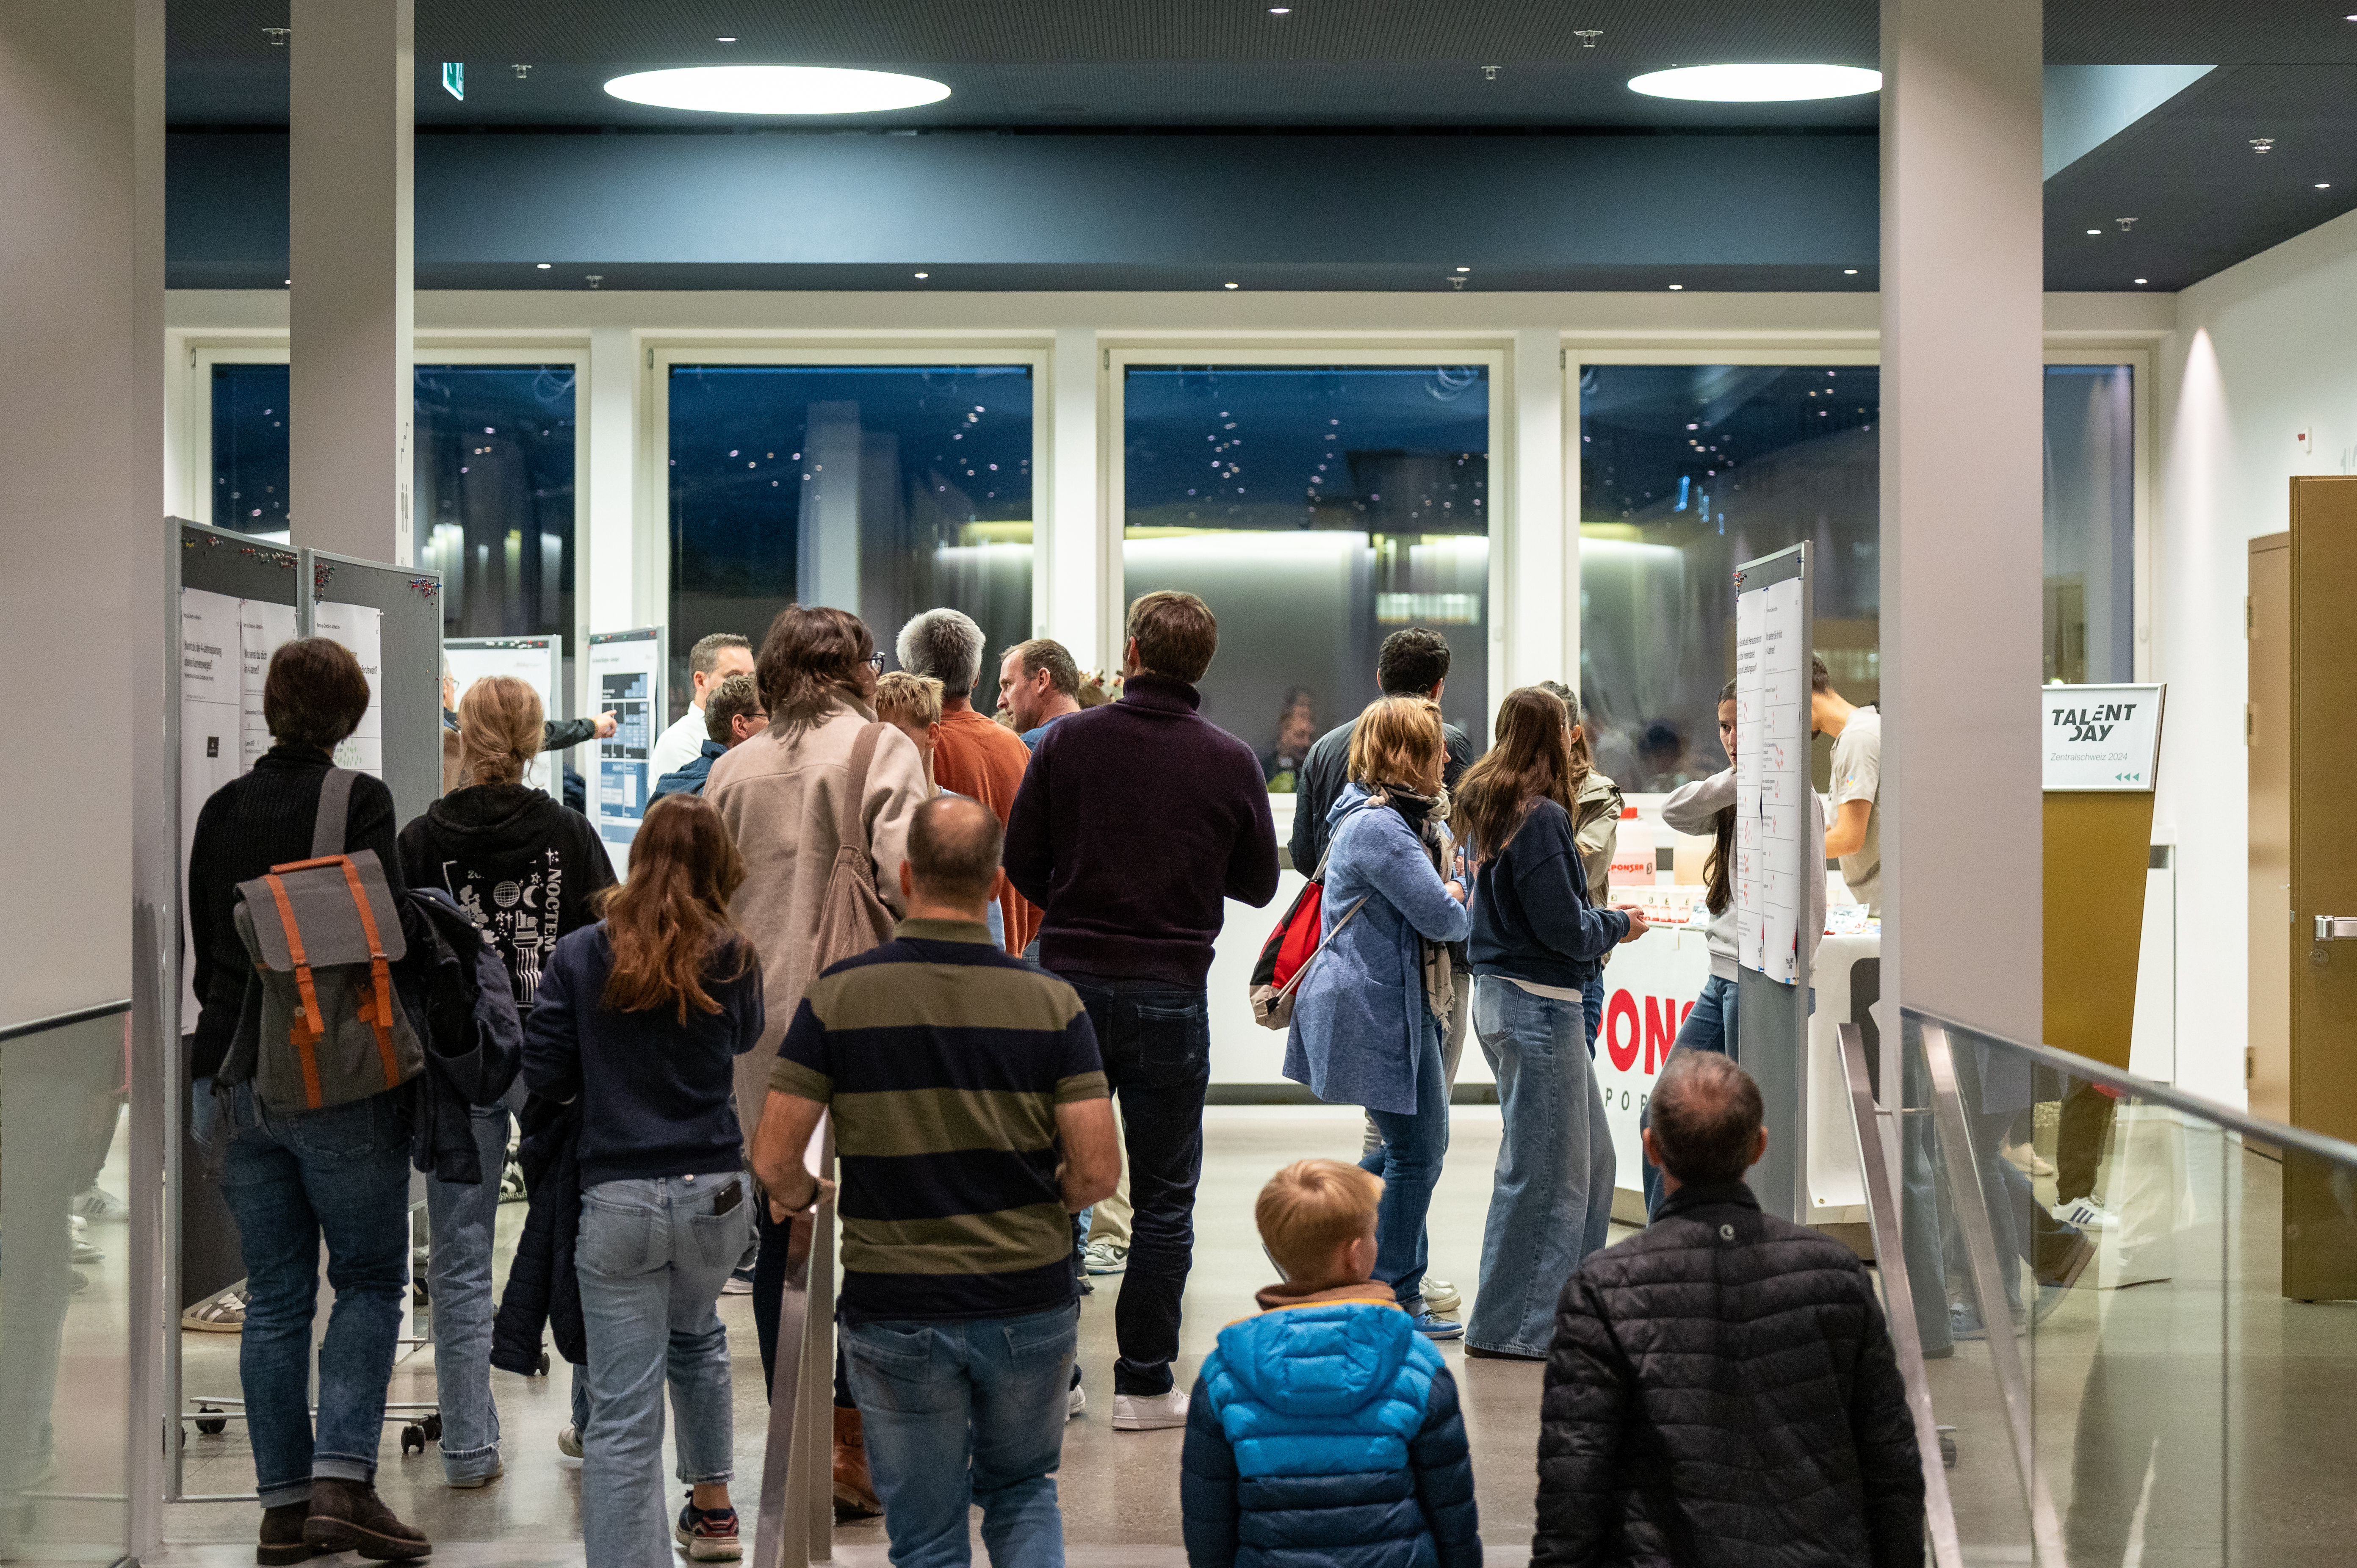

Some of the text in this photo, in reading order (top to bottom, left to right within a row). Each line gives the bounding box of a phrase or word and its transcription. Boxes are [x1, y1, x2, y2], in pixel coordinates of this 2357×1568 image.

[2051, 704, 2137, 725] TALENT
[2068, 725, 2114, 741] DAY
[2050, 752, 2127, 761] Zentralschweiz 2024
[1608, 864, 1644, 873] PONSER
[545, 868, 562, 952] NOCTEM
[1597, 988, 1695, 1075] ON
